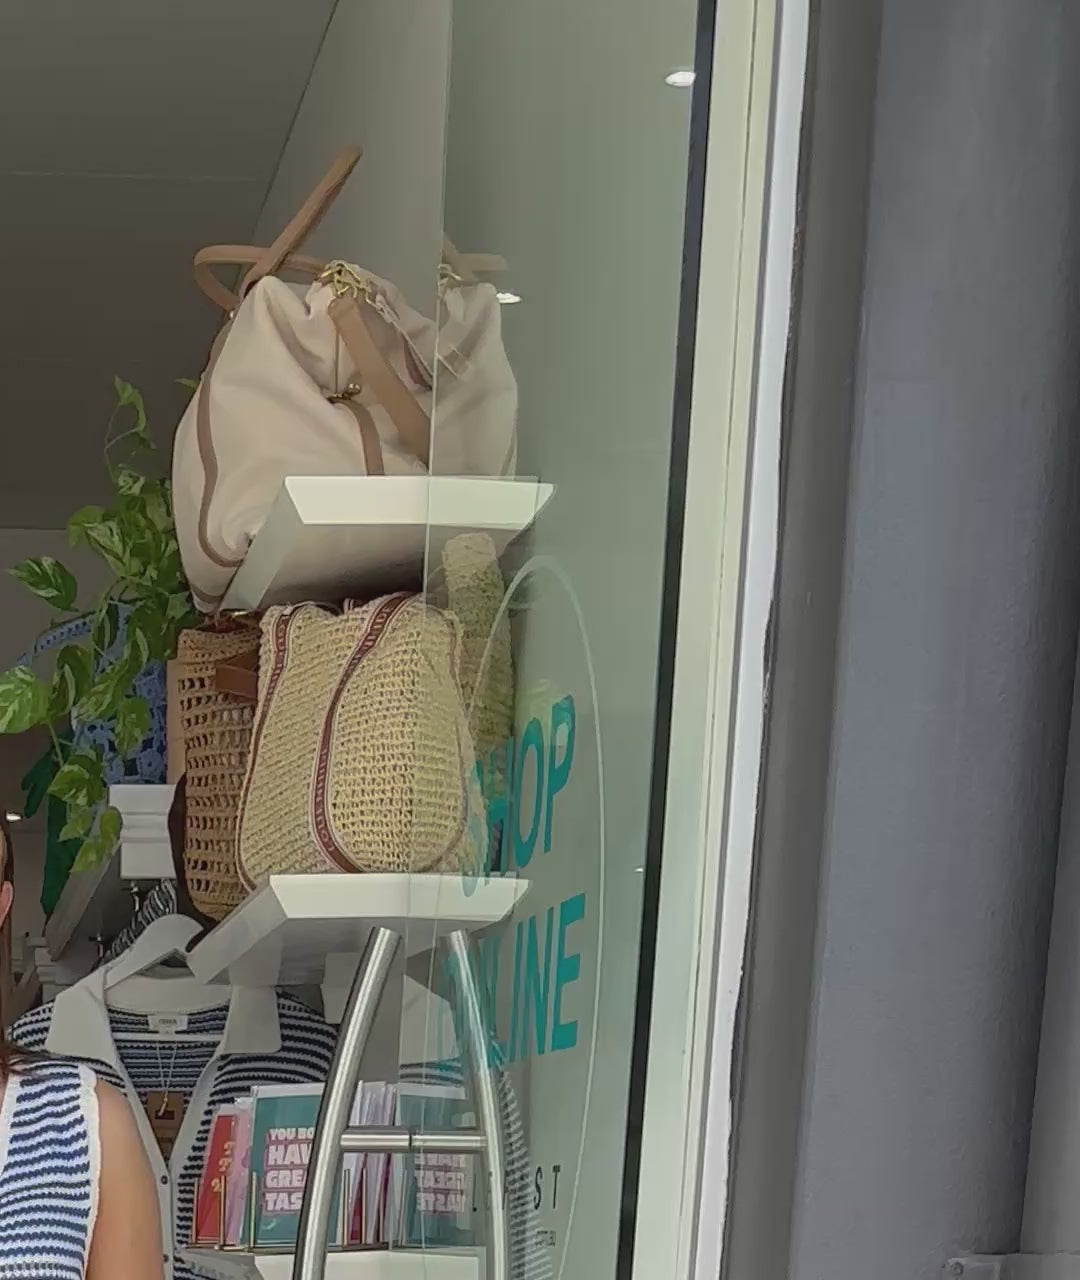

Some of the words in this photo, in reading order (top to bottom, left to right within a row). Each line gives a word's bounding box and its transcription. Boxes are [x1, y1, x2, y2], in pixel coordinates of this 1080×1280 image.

[269, 1127, 295, 1141] YOU
[297, 1127, 316, 1141] BO
[268, 1143, 313, 1165] HAV
[265, 1169, 307, 1189] GRE
[265, 1192, 303, 1211] TAS
